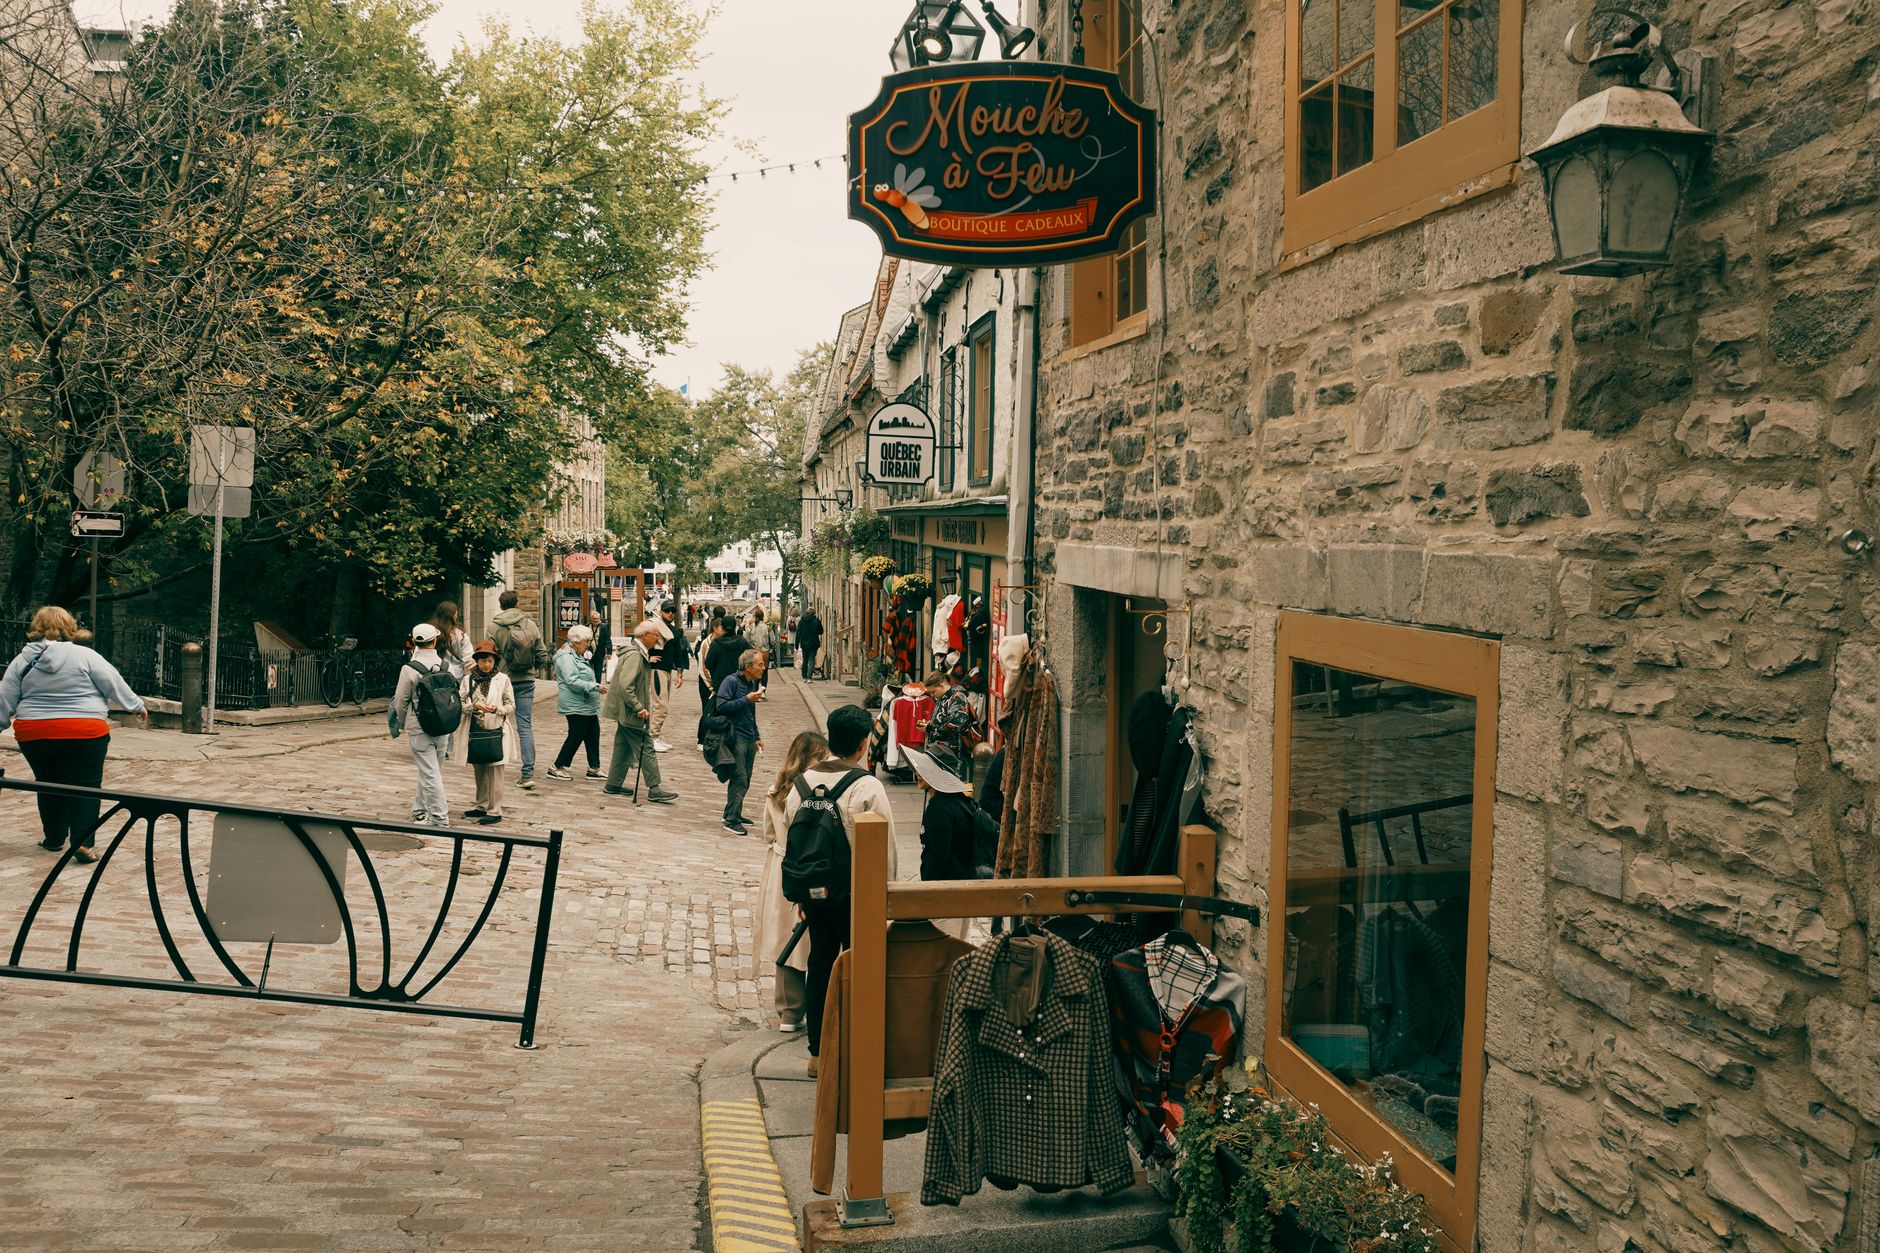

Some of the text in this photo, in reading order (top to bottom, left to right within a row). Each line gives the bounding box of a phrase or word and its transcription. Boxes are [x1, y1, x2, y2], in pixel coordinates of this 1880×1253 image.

[886, 74, 1090, 155] Mouche
[943, 142, 1075, 199] à Feu
[930, 212, 1085, 235] BOUTIQUE CADEAUX
[880, 441, 922, 461] QUÉBEC
[880, 460, 920, 478] URBAIN
